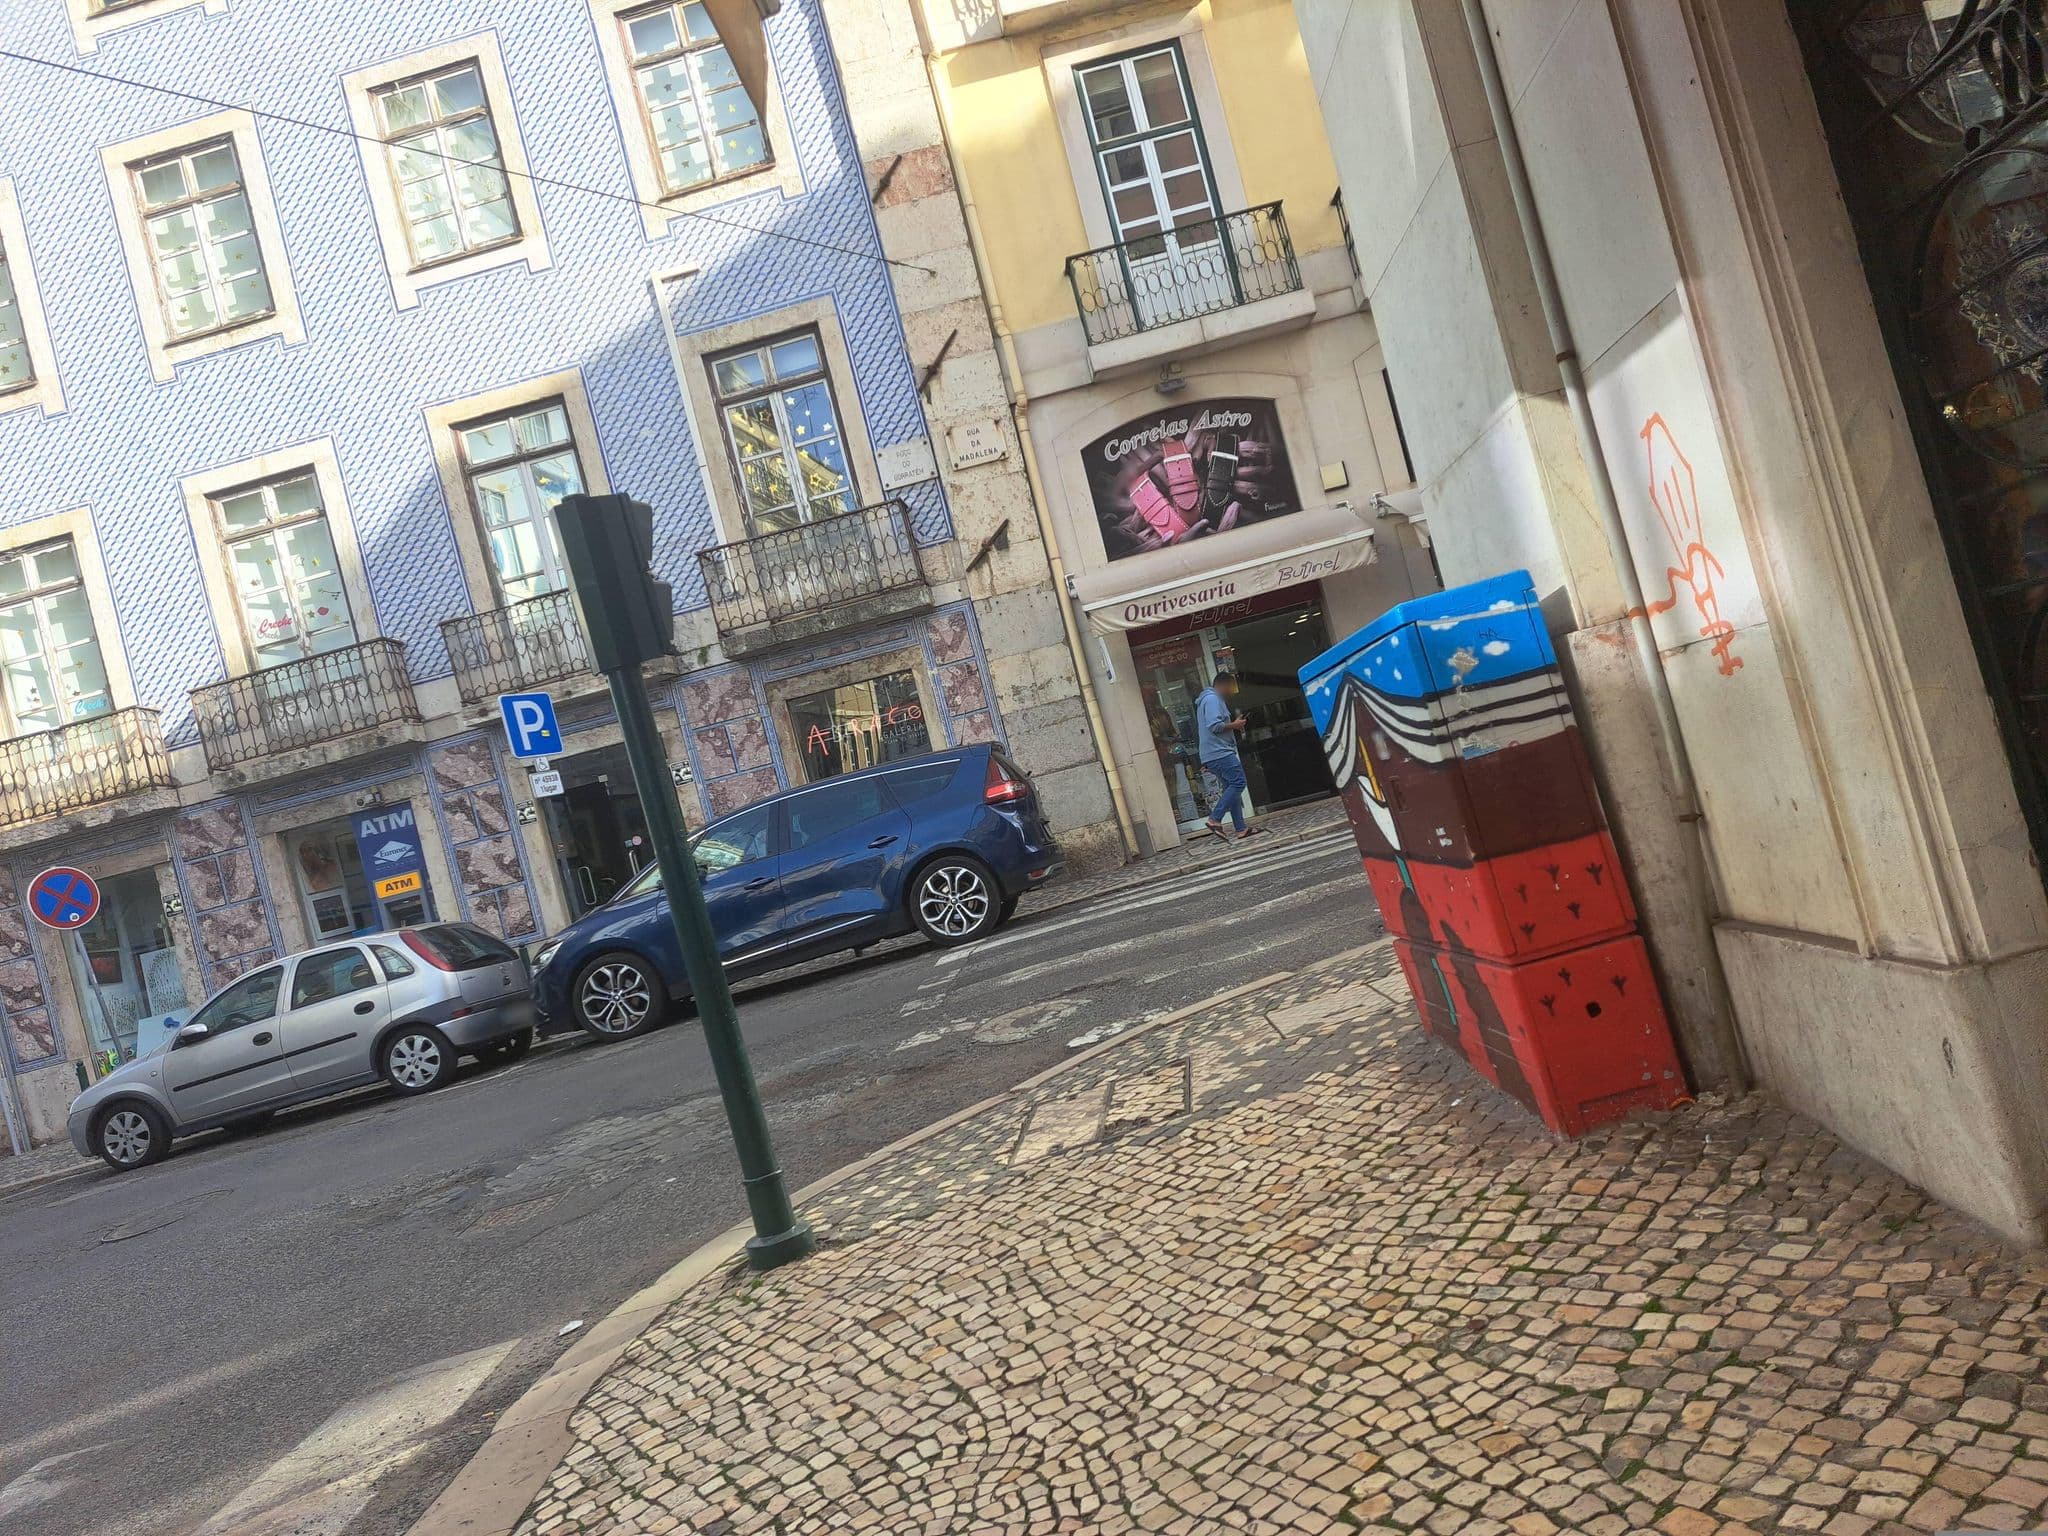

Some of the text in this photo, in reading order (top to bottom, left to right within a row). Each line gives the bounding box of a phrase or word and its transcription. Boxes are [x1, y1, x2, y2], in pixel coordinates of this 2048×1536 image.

[966, 428, 981, 438] RUA
[1104, 409, 1252, 462] Correias Astro
[970, 439, 982, 449] DA
[959, 446, 999, 462] MADALENA
[1124, 580, 1237, 623] Ourivesaria
[513, 701, 545, 751] P
[883, 721, 925, 739] GALERIA
[361, 809, 414, 838] ATM
[385, 878, 413, 893] ATM
